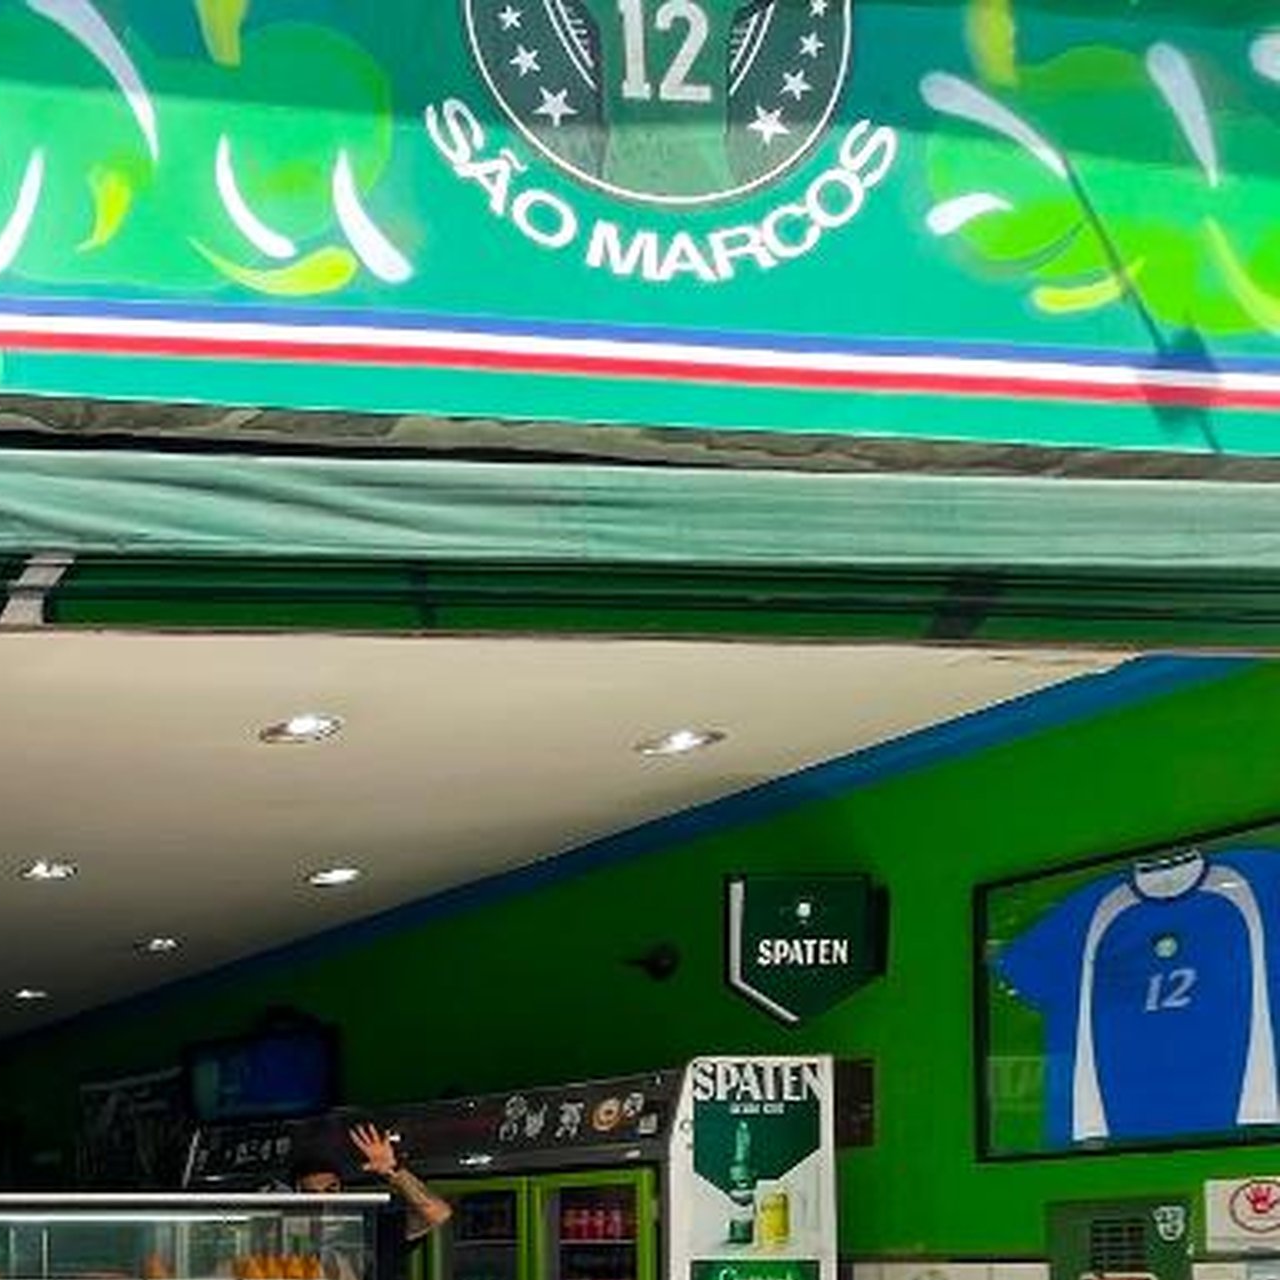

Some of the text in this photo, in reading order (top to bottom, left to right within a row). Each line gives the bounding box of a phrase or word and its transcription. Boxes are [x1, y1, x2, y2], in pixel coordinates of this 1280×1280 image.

[618, 0, 713, 102] 12
[425, 98, 899, 283] SÃO MARCOS
[757, 938, 848, 966] SPATEN
[1146, 968, 1195, 1012] 12
[693, 1062, 824, 1102] SPATEN
